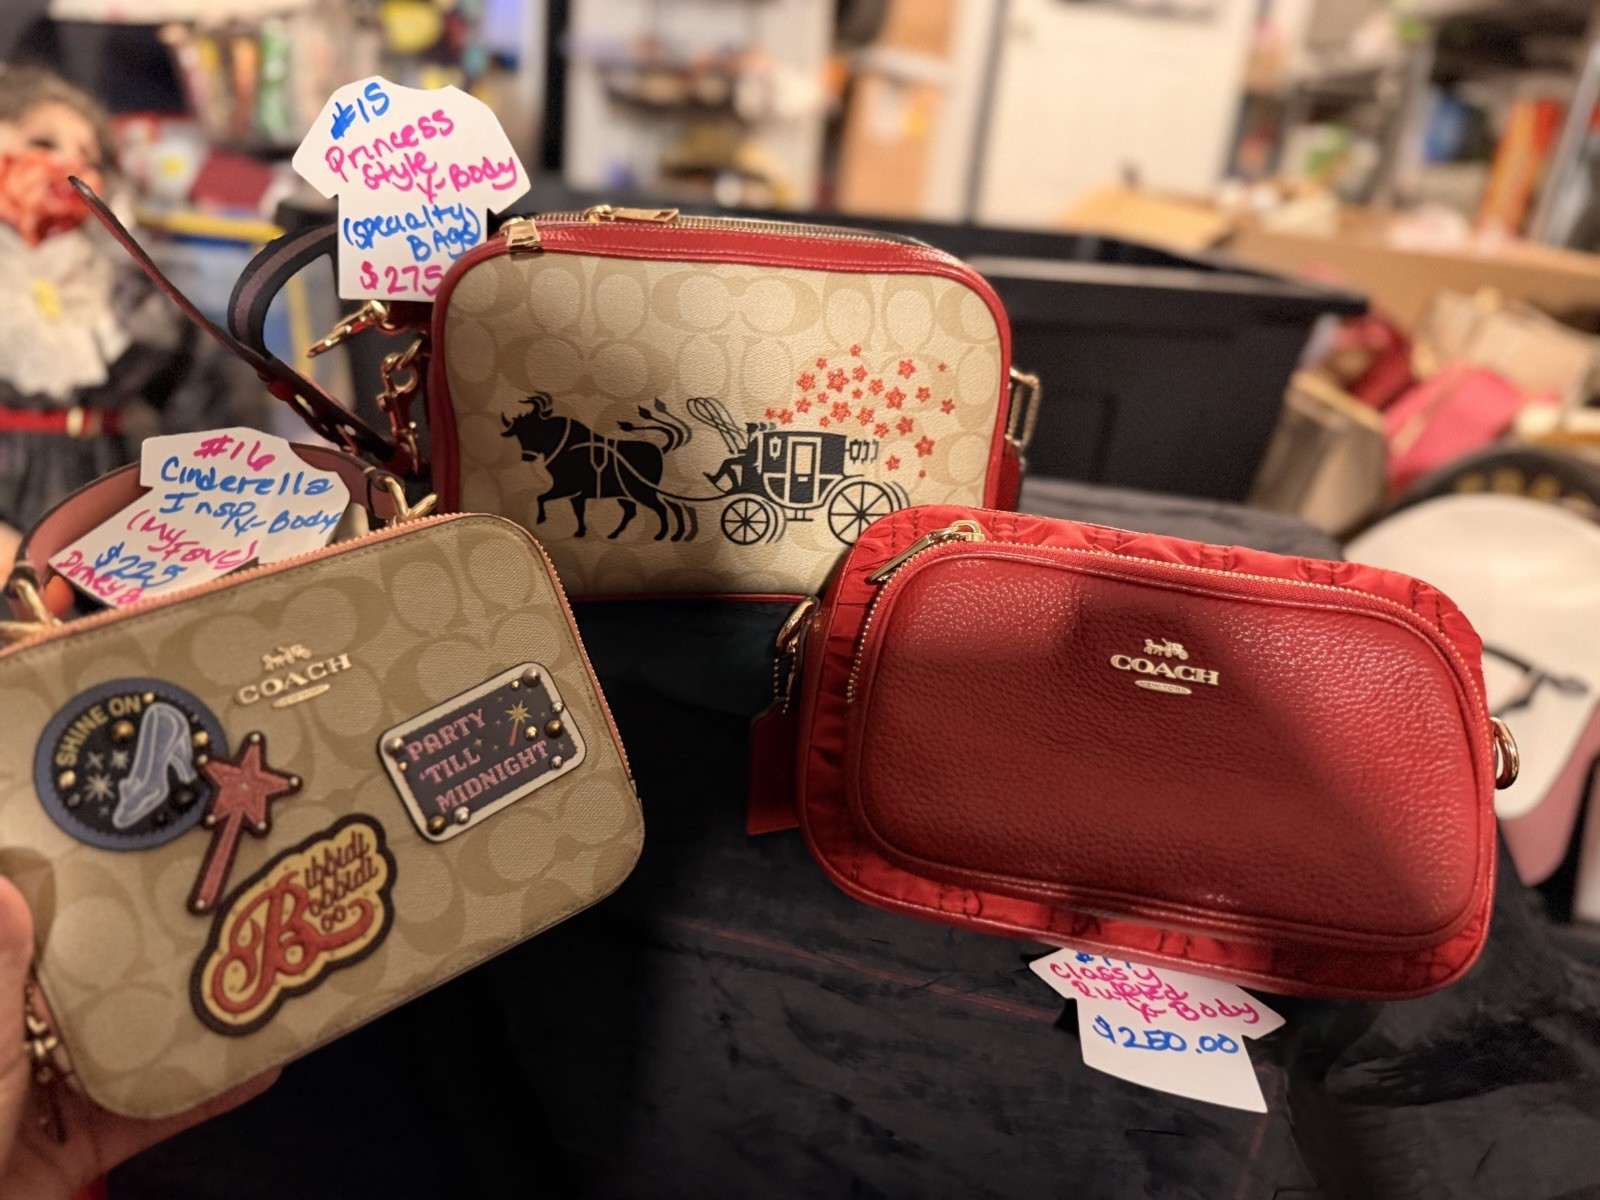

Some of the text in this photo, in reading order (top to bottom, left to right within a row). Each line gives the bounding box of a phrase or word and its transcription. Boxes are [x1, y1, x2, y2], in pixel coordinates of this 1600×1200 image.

[330, 82, 390, 140] #15
[325, 109, 455, 182] Princess
[360, 260, 443, 297] $275
[160, 456, 333, 496] Cinderella
[193, 434, 275, 471] #16
[94, 541, 188, 588] $225
[237, 653, 352, 704] COACH
[1110, 654, 1220, 685] COACH
[56, 694, 141, 767] SHINE ON
[405, 708, 486, 763] PARTY
[434, 739, 550, 813] MIDNIGHT
[1050, 962, 1163, 989] Classy
